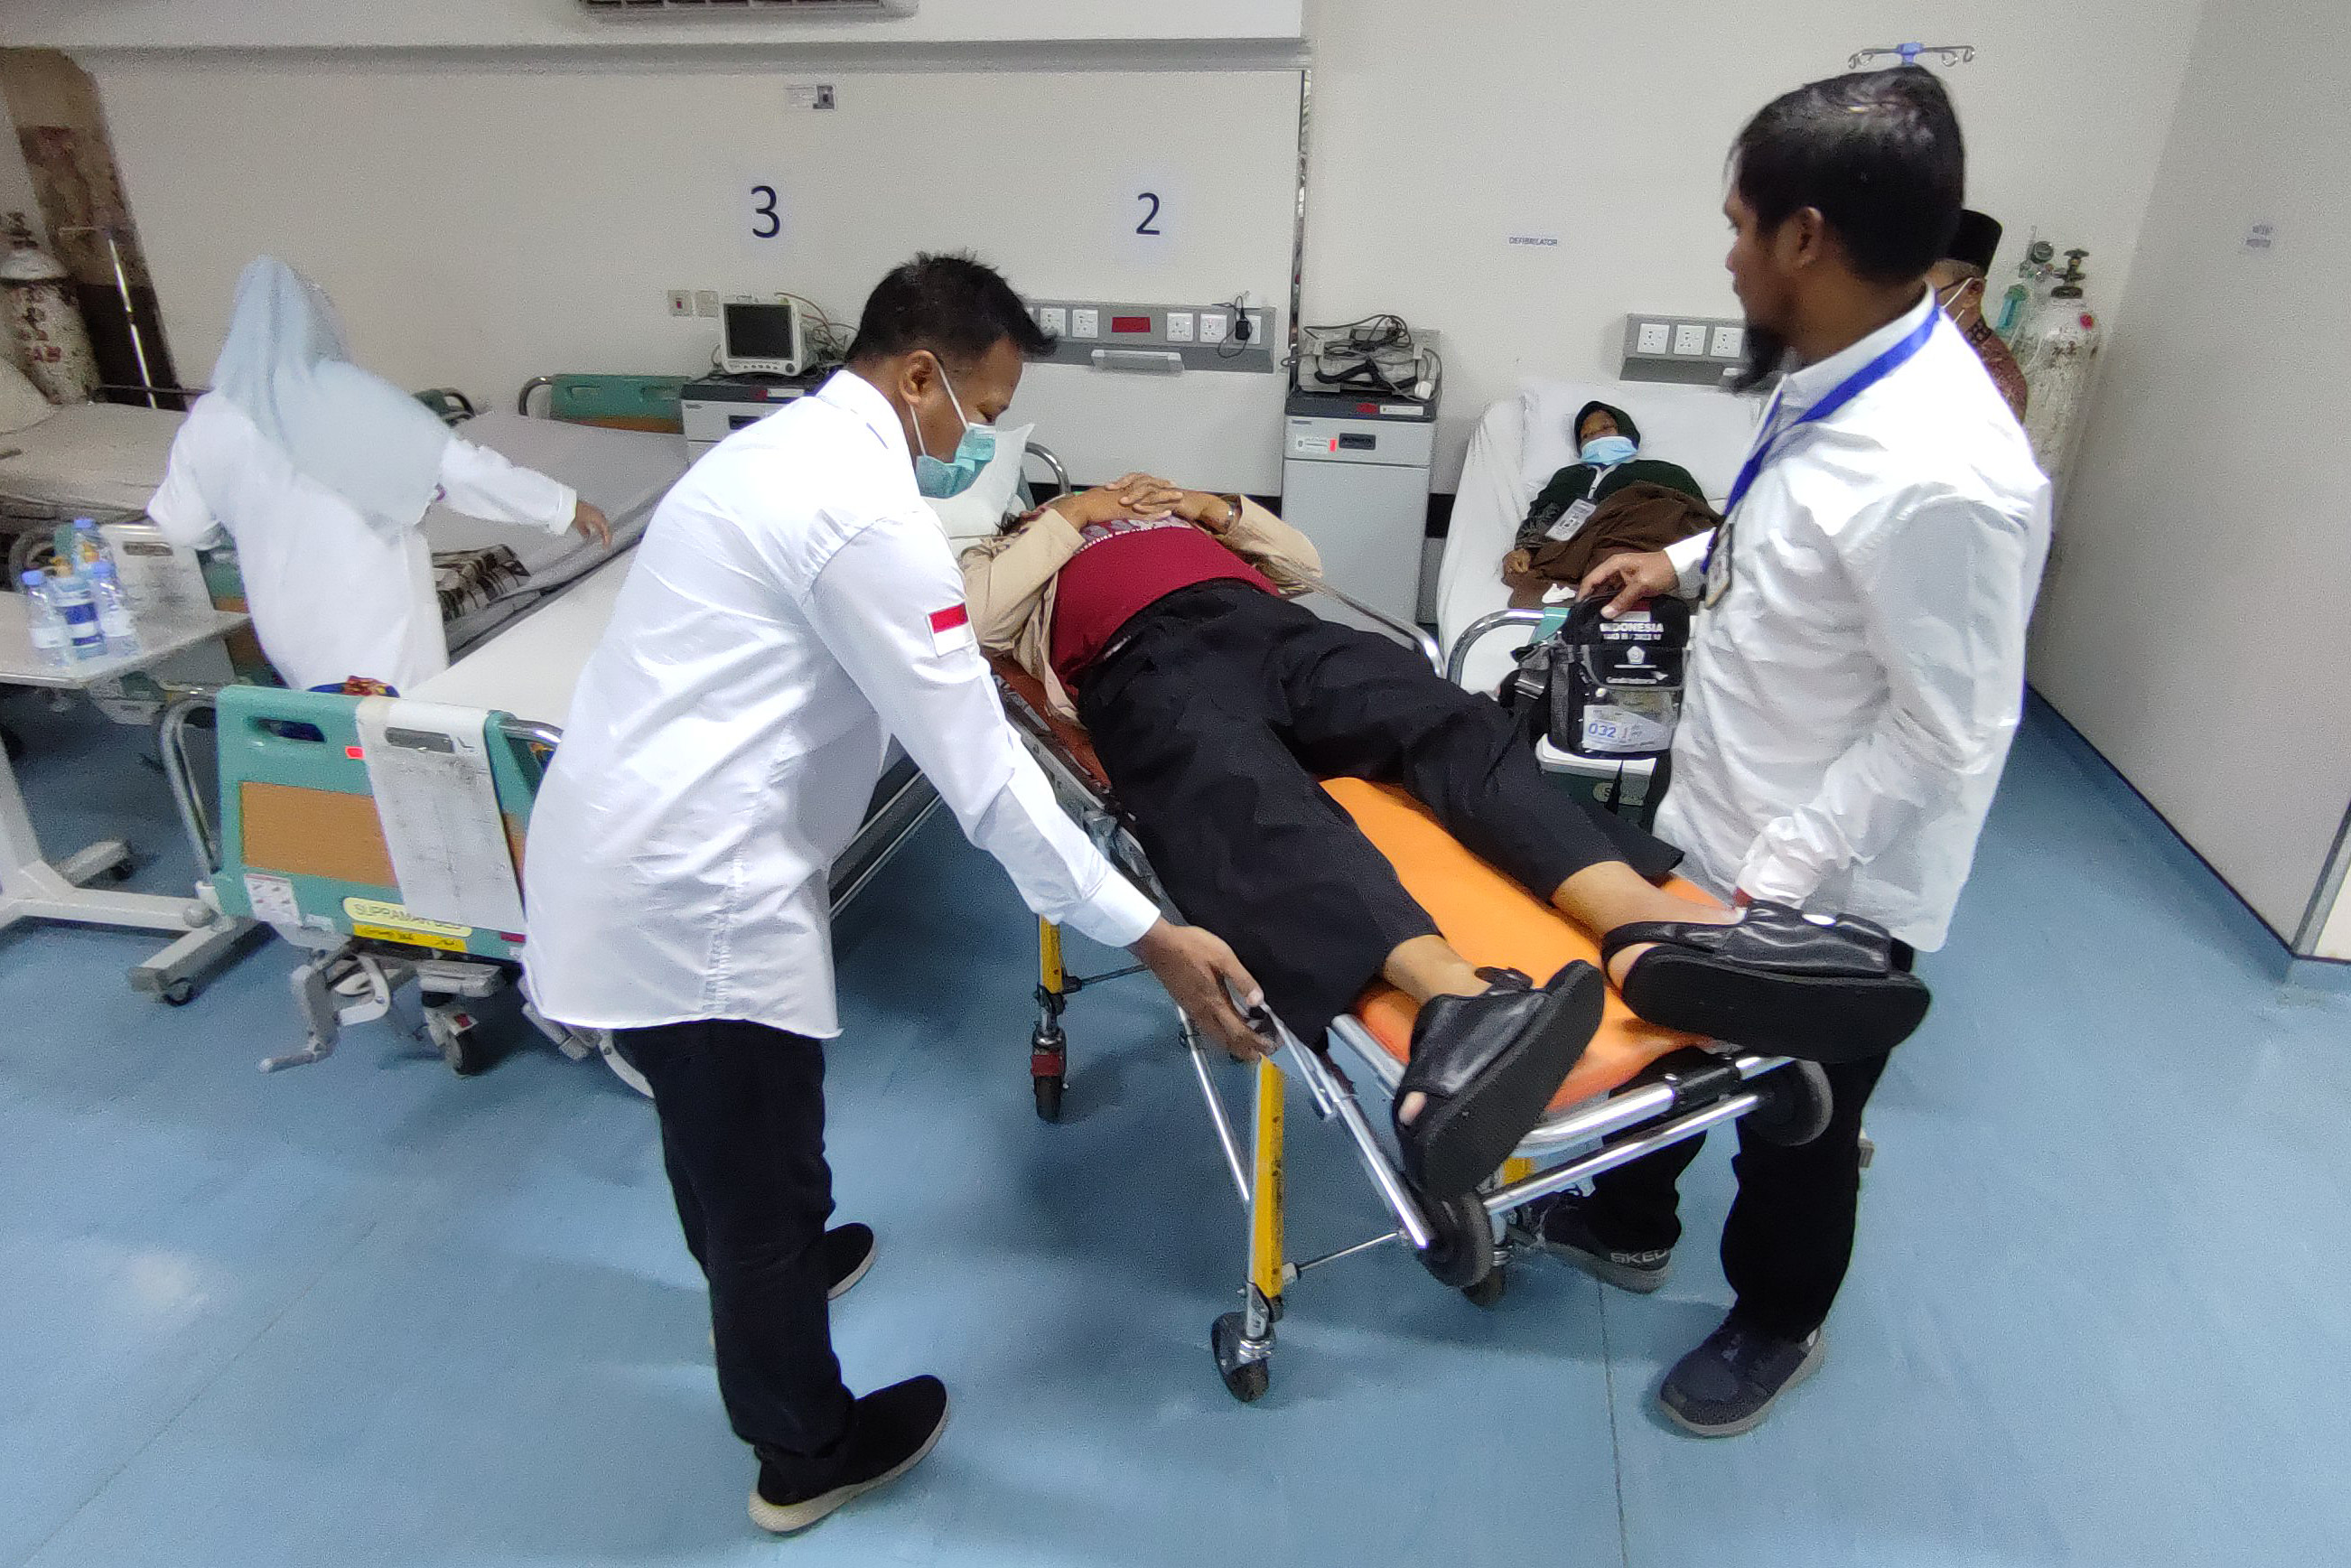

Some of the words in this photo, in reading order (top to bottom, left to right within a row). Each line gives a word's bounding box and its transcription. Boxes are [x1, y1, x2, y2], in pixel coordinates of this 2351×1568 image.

[751, 185, 781, 238] 3
[1135, 192, 1162, 236] 2
[1599, 622, 1665, 632] INDONESIA
[1588, 723, 1617, 738] 032
